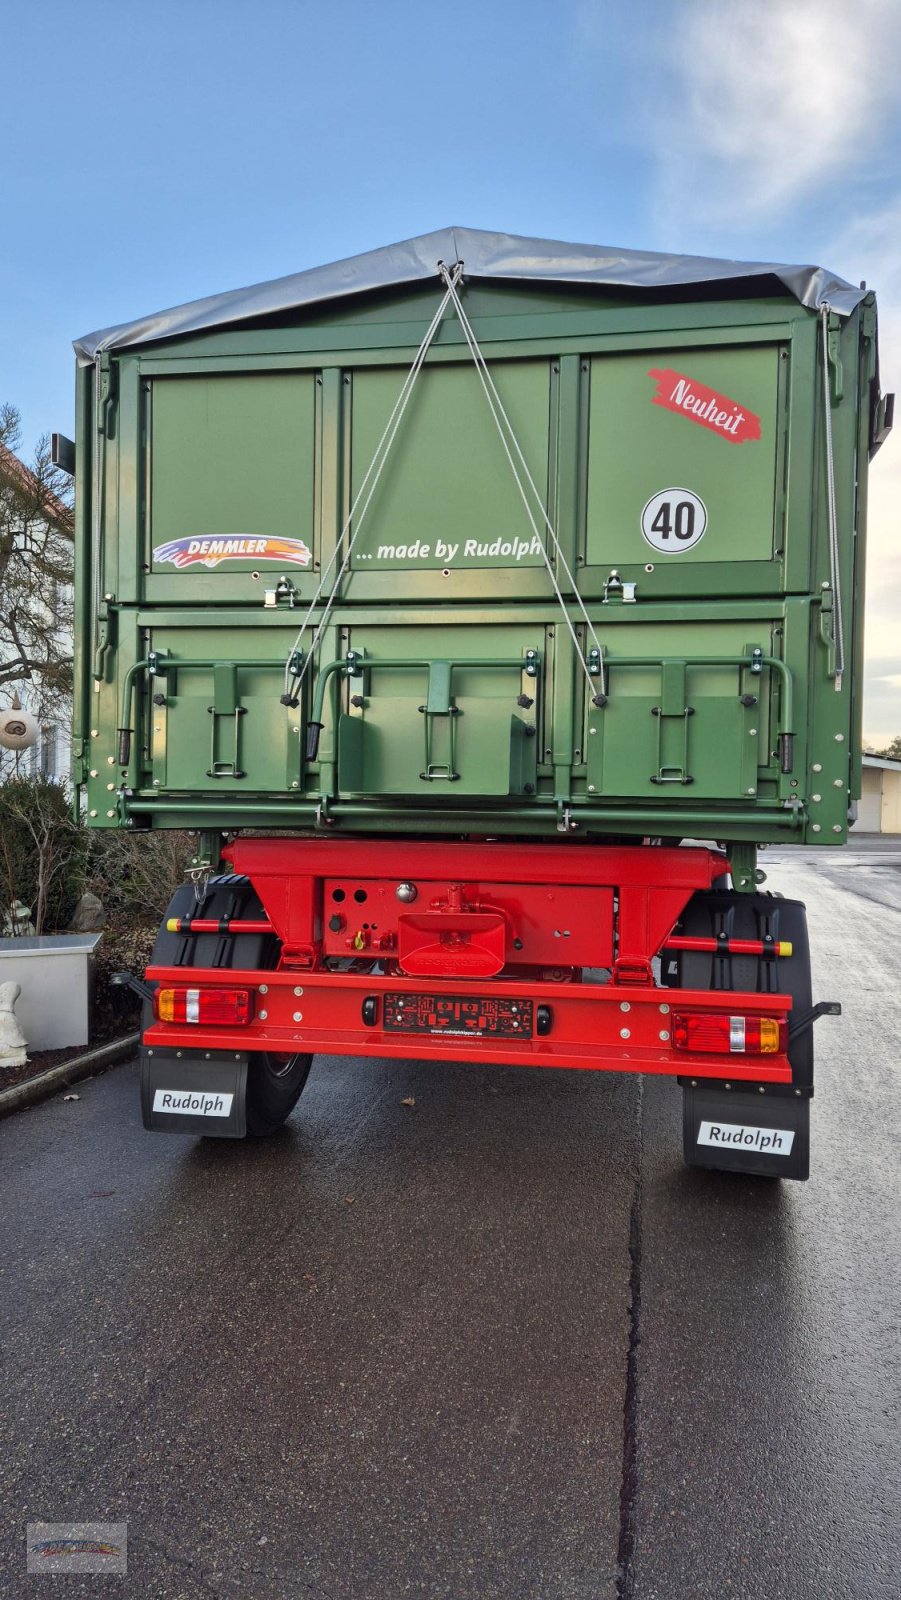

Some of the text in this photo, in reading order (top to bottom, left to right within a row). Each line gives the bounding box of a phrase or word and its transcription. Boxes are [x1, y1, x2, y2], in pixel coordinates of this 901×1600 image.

[669, 379, 746, 434] Neuheit
[650, 501, 696, 540] 40
[187, 539, 269, 555] DEMMLER
[377, 539, 431, 559] made
[434, 538, 459, 563] by
[463, 536, 541, 561] Rudolph
[162, 1093, 224, 1115] Rudolph
[709, 1126, 783, 1151] Rudolph
